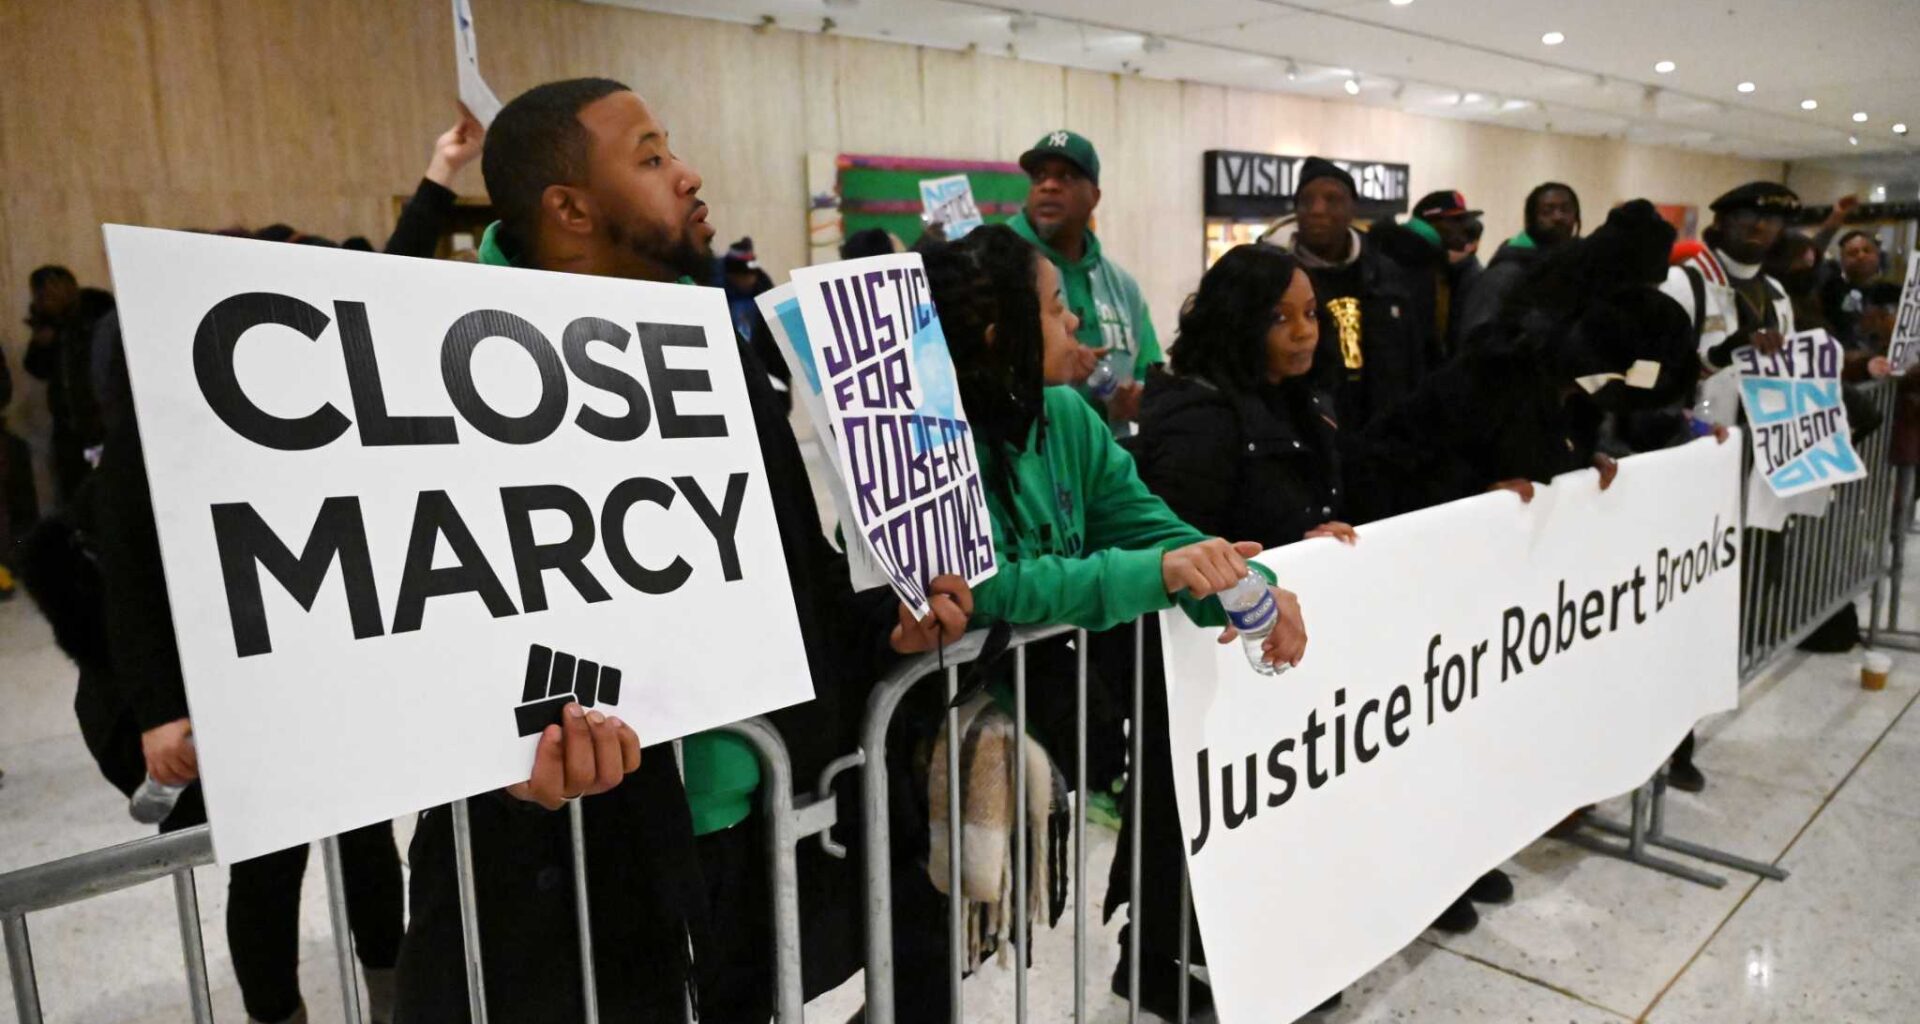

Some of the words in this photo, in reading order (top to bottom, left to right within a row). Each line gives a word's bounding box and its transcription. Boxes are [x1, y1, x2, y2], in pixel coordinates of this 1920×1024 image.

[1220, 155, 1301, 196] VISIT
[192, 291, 729, 451] CLOSE
[820, 268, 936, 377] JUSTIC
[833, 347, 916, 411] FOR
[1742, 378, 1840, 425] NO
[842, 414, 976, 526] ROBERT
[1756, 407, 1842, 475] JUSTICE
[1770, 432, 1858, 490] NO
[210, 472, 749, 658] MARCY
[867, 473, 994, 610] BROOKS
[1191, 687, 1412, 856] Justice
[1424, 633, 1488, 725] for
[1501, 564, 1647, 683] Robert
[1656, 513, 1737, 613] Brooks
